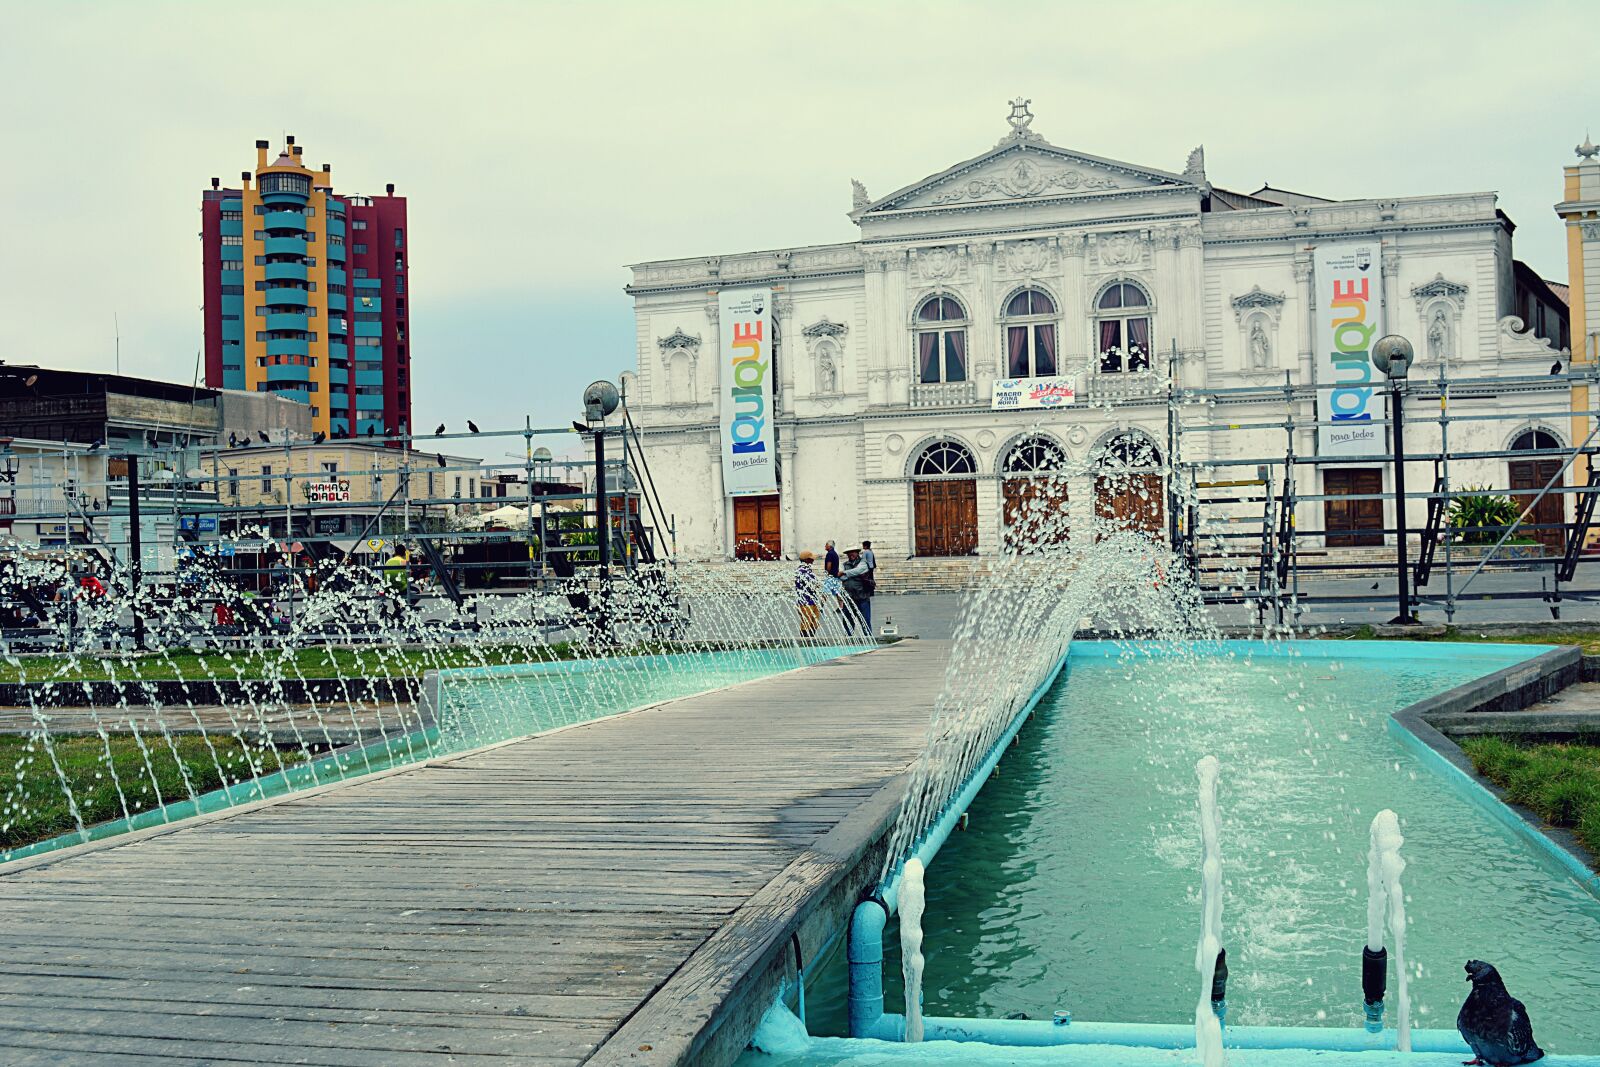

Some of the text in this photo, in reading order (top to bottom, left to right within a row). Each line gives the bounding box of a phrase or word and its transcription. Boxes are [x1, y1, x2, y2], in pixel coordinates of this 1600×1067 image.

[731, 320, 769, 454] IQUIQUE
[1330, 277, 1377, 426] IQUIQUE
[732, 455, 768, 469] para todos
[1330, 428, 1375, 443] para todos
